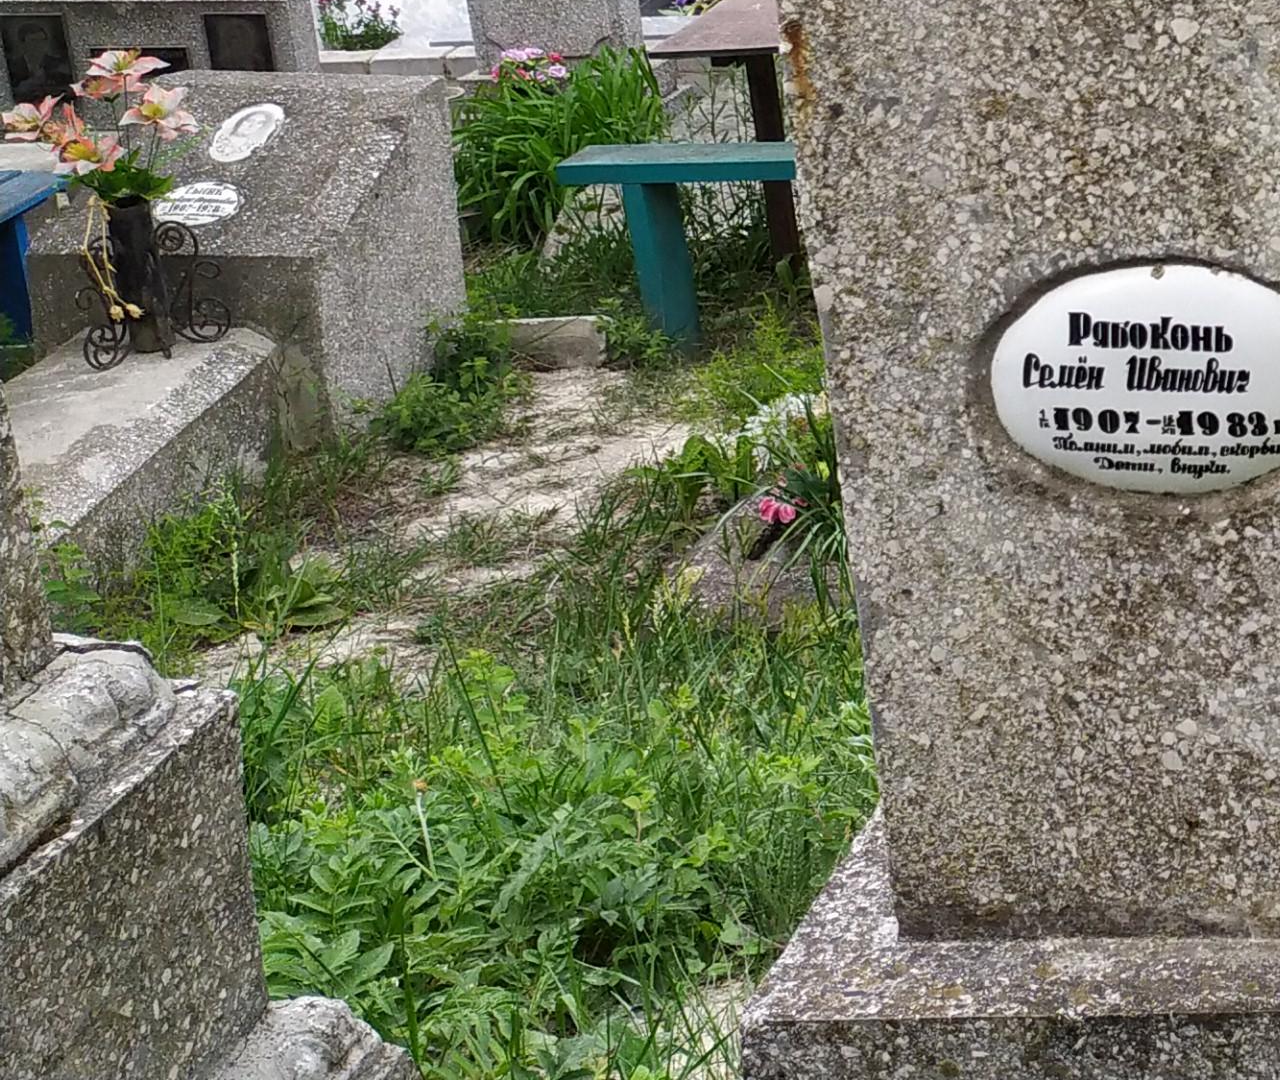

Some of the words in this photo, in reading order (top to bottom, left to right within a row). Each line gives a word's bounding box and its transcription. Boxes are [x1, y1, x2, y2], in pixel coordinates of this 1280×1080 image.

[1022, 353, 1106, 390] Семён
[1125, 355, 1251, 394] Иванович
[1053, 407, 1140, 434] 1907
